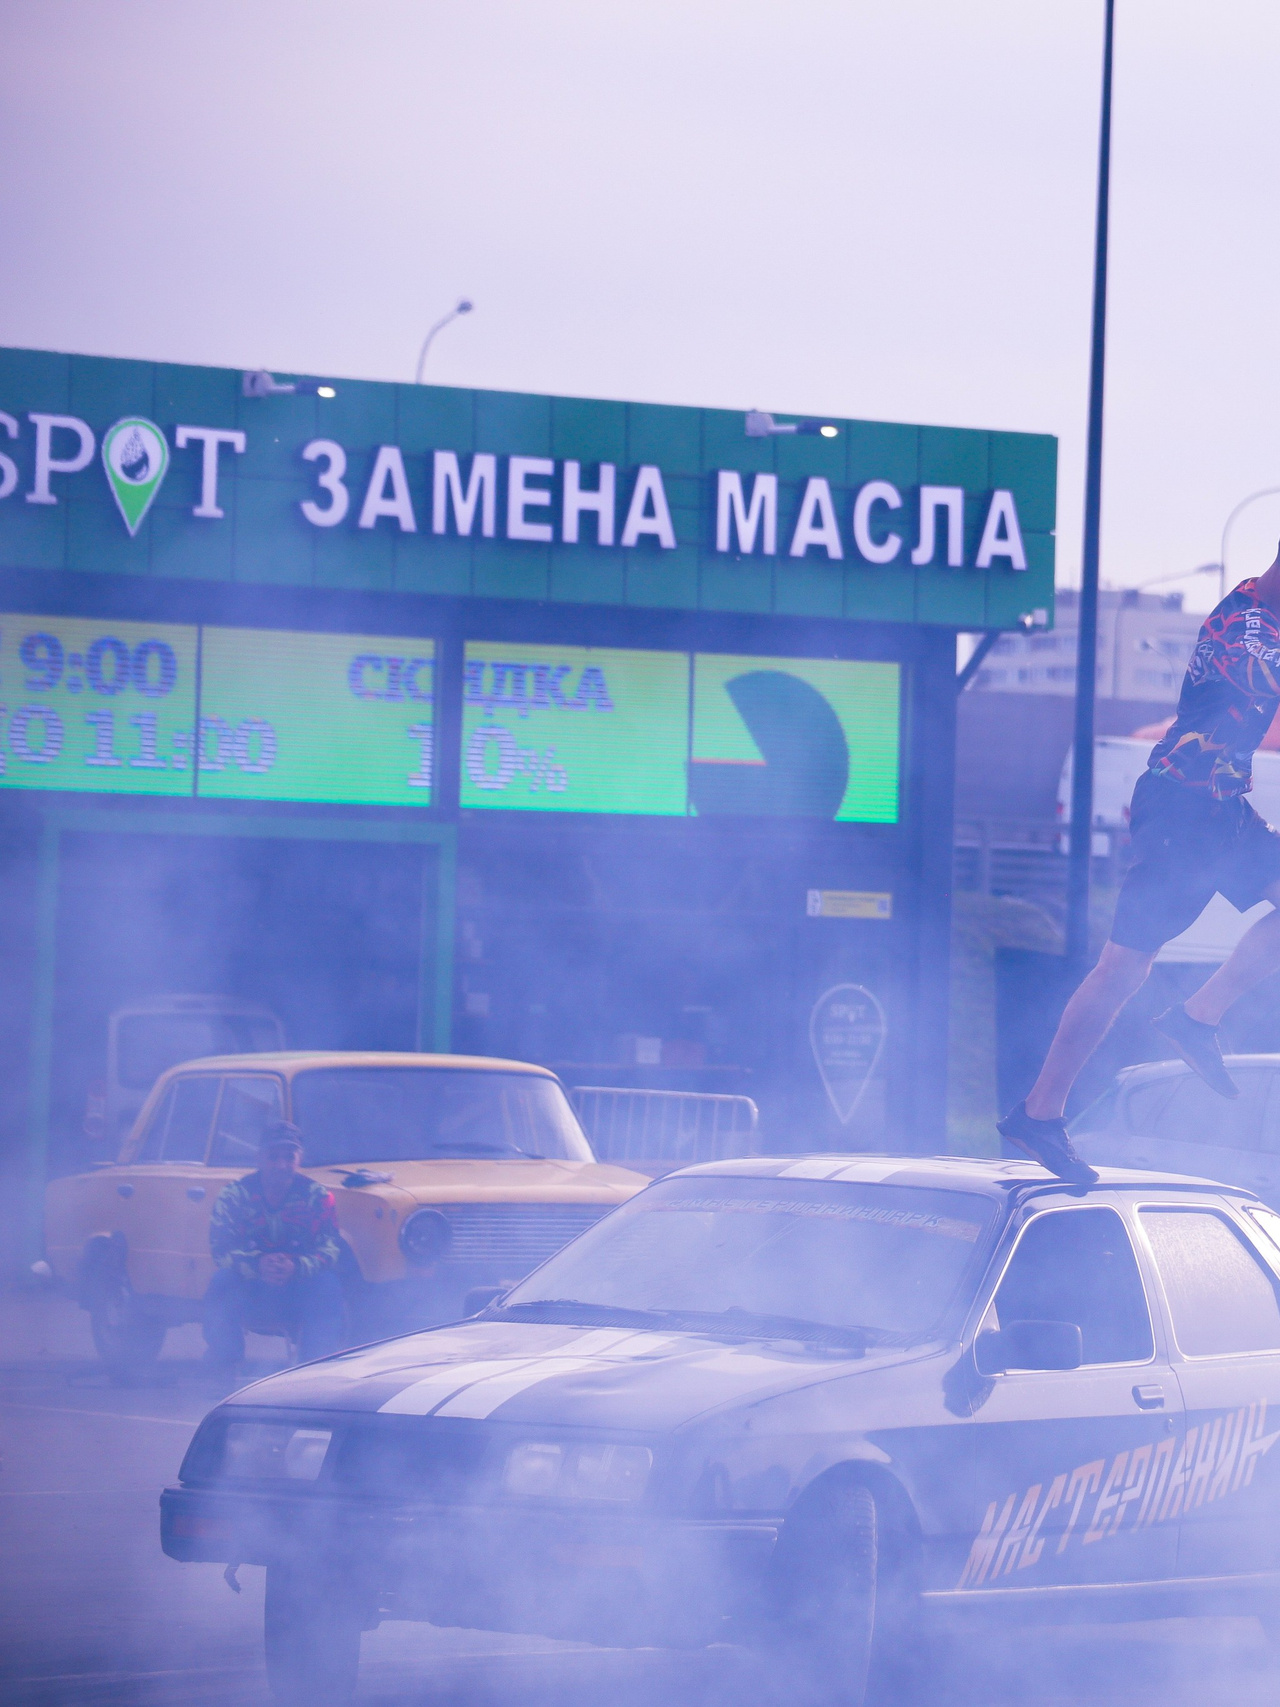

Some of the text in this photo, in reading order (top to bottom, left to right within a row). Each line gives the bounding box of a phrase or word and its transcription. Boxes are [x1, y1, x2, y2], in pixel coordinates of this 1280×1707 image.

[301, 438, 1027, 571] ЗАМЕНА МАСЛА
[19, 632, 177, 697] 9:00
[84, 708, 278, 773] 11:00
